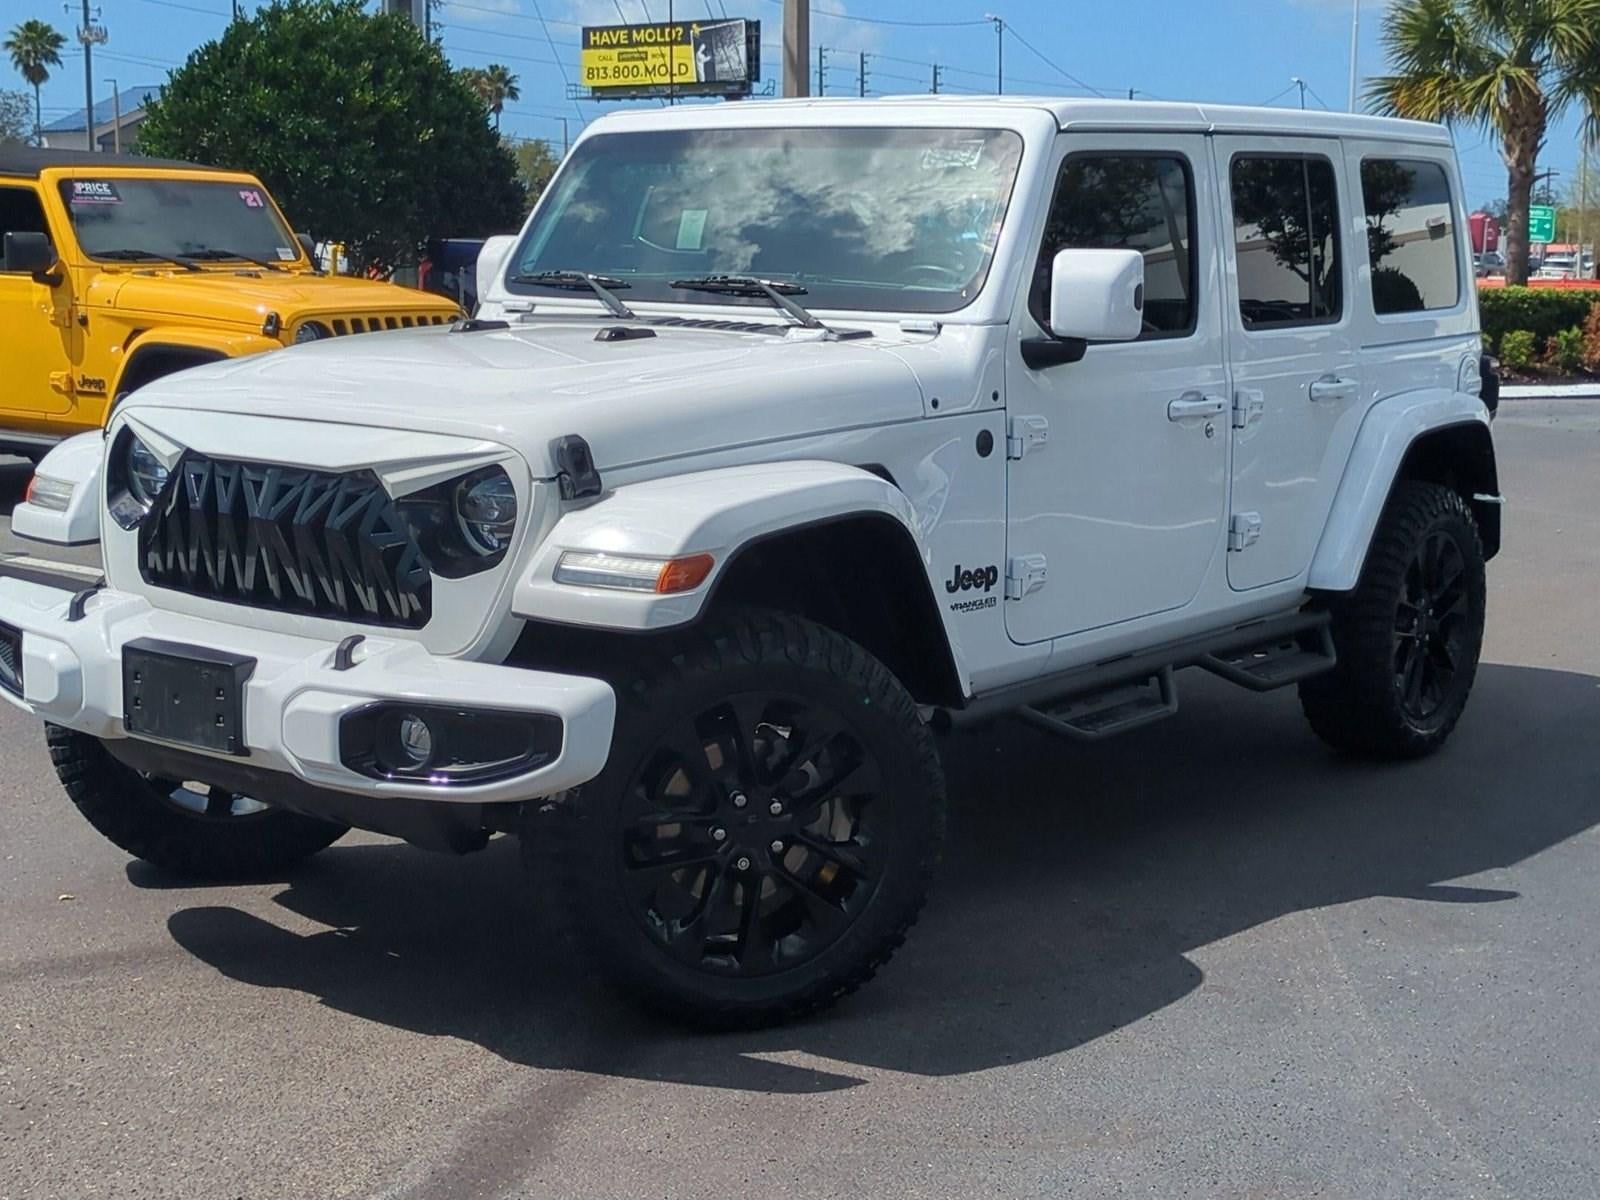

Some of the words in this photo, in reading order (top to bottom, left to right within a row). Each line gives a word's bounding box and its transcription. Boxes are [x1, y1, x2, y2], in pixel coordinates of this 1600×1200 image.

[590, 29, 629, 45] HAVE
[632, 27, 684, 43] MOLD?
[77, 374, 106, 391] Jeep
[945, 564, 998, 594] Jeep
